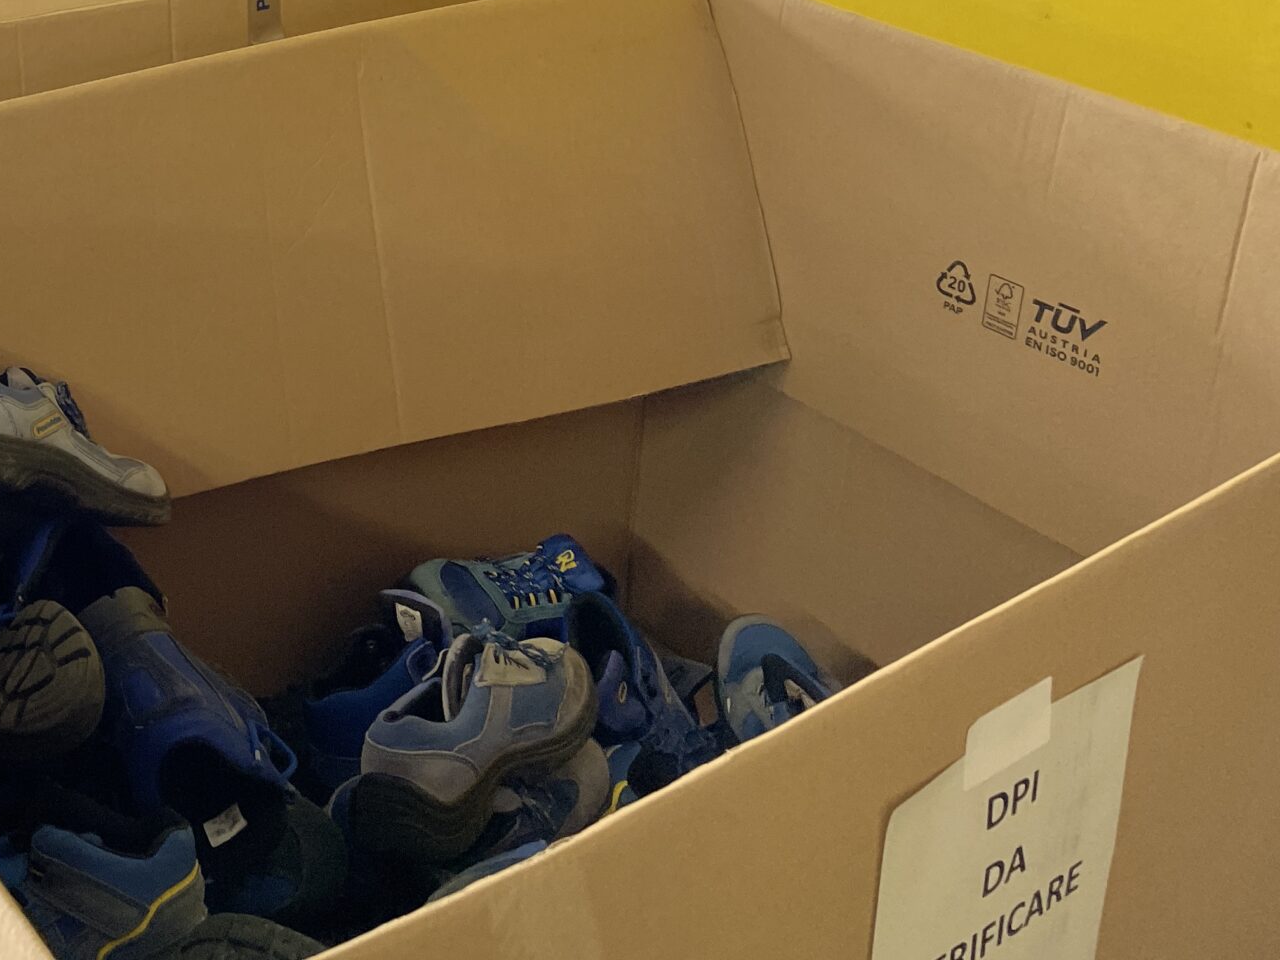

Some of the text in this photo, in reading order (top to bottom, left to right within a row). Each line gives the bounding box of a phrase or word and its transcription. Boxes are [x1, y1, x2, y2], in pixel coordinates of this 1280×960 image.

[947, 276, 966, 293] 20
[943, 300, 964, 315] PAP
[1024, 336, 1100, 377] EN ISO 9001
[1027, 326, 1101, 364] AUSTRIA
[986, 769, 1040, 831] DPI
[982, 845, 1026, 898] DA
[934, 860, 1083, 960] RIFICARE
